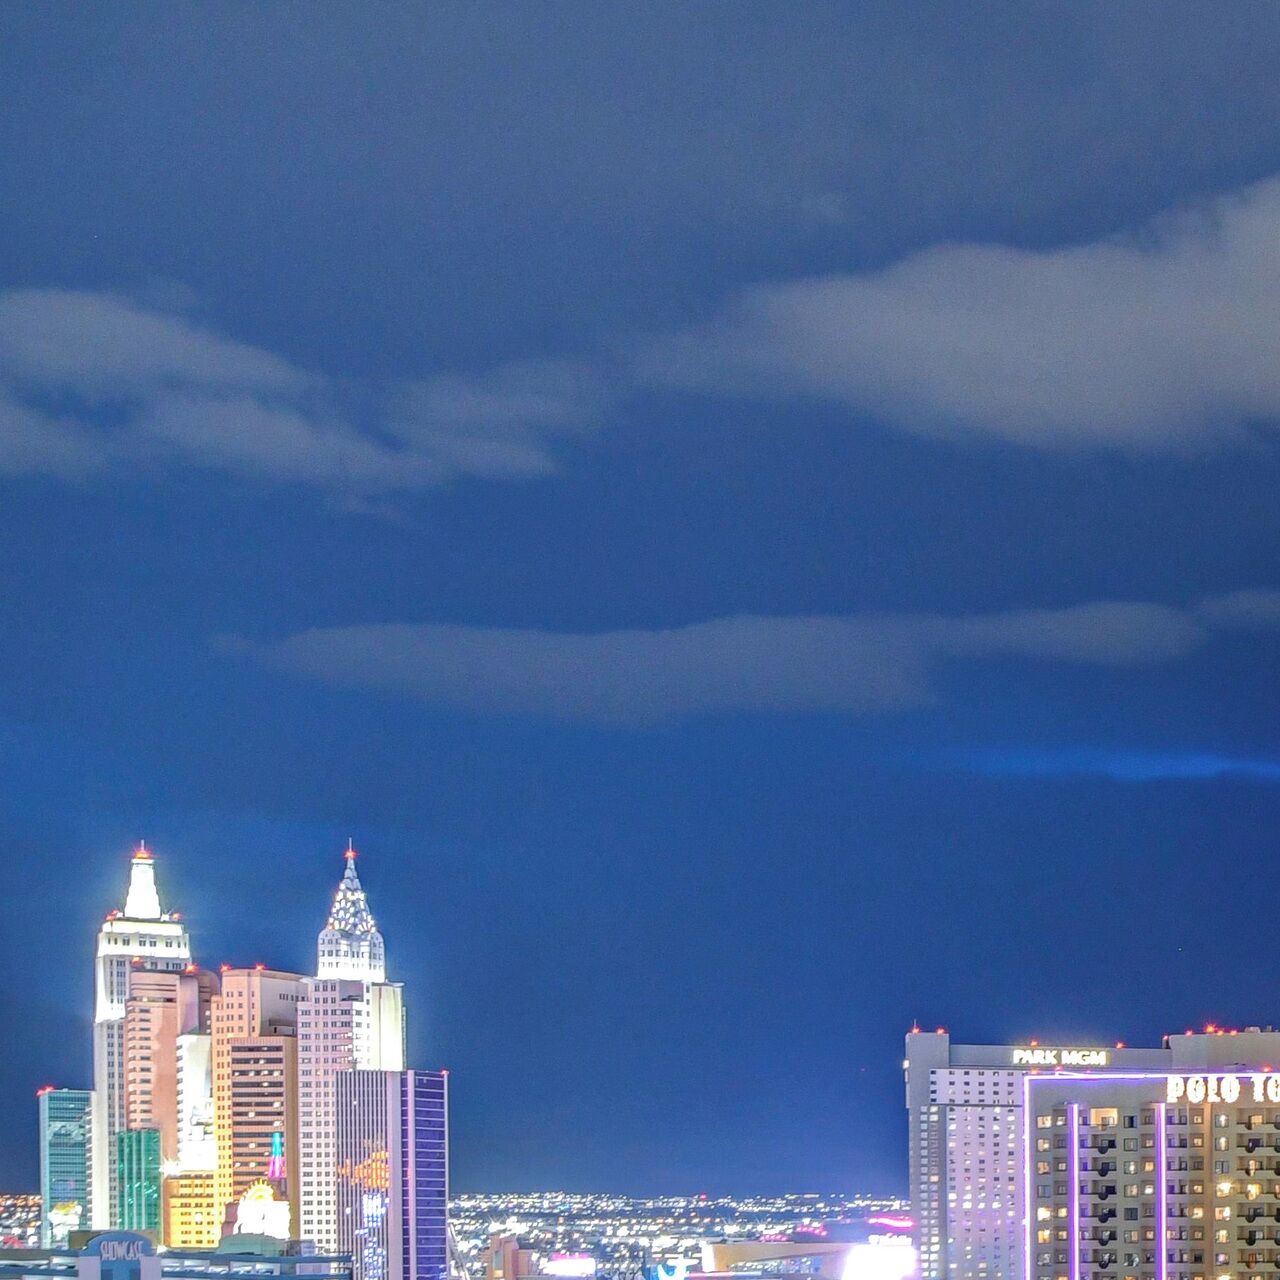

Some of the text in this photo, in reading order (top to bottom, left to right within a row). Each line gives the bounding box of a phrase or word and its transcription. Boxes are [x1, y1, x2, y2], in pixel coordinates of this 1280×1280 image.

[1013, 1050, 1106, 1065] PARK MGM
[1167, 1075, 1240, 1103] POLO
[101, 1241, 144, 1260] SHOWCASE
